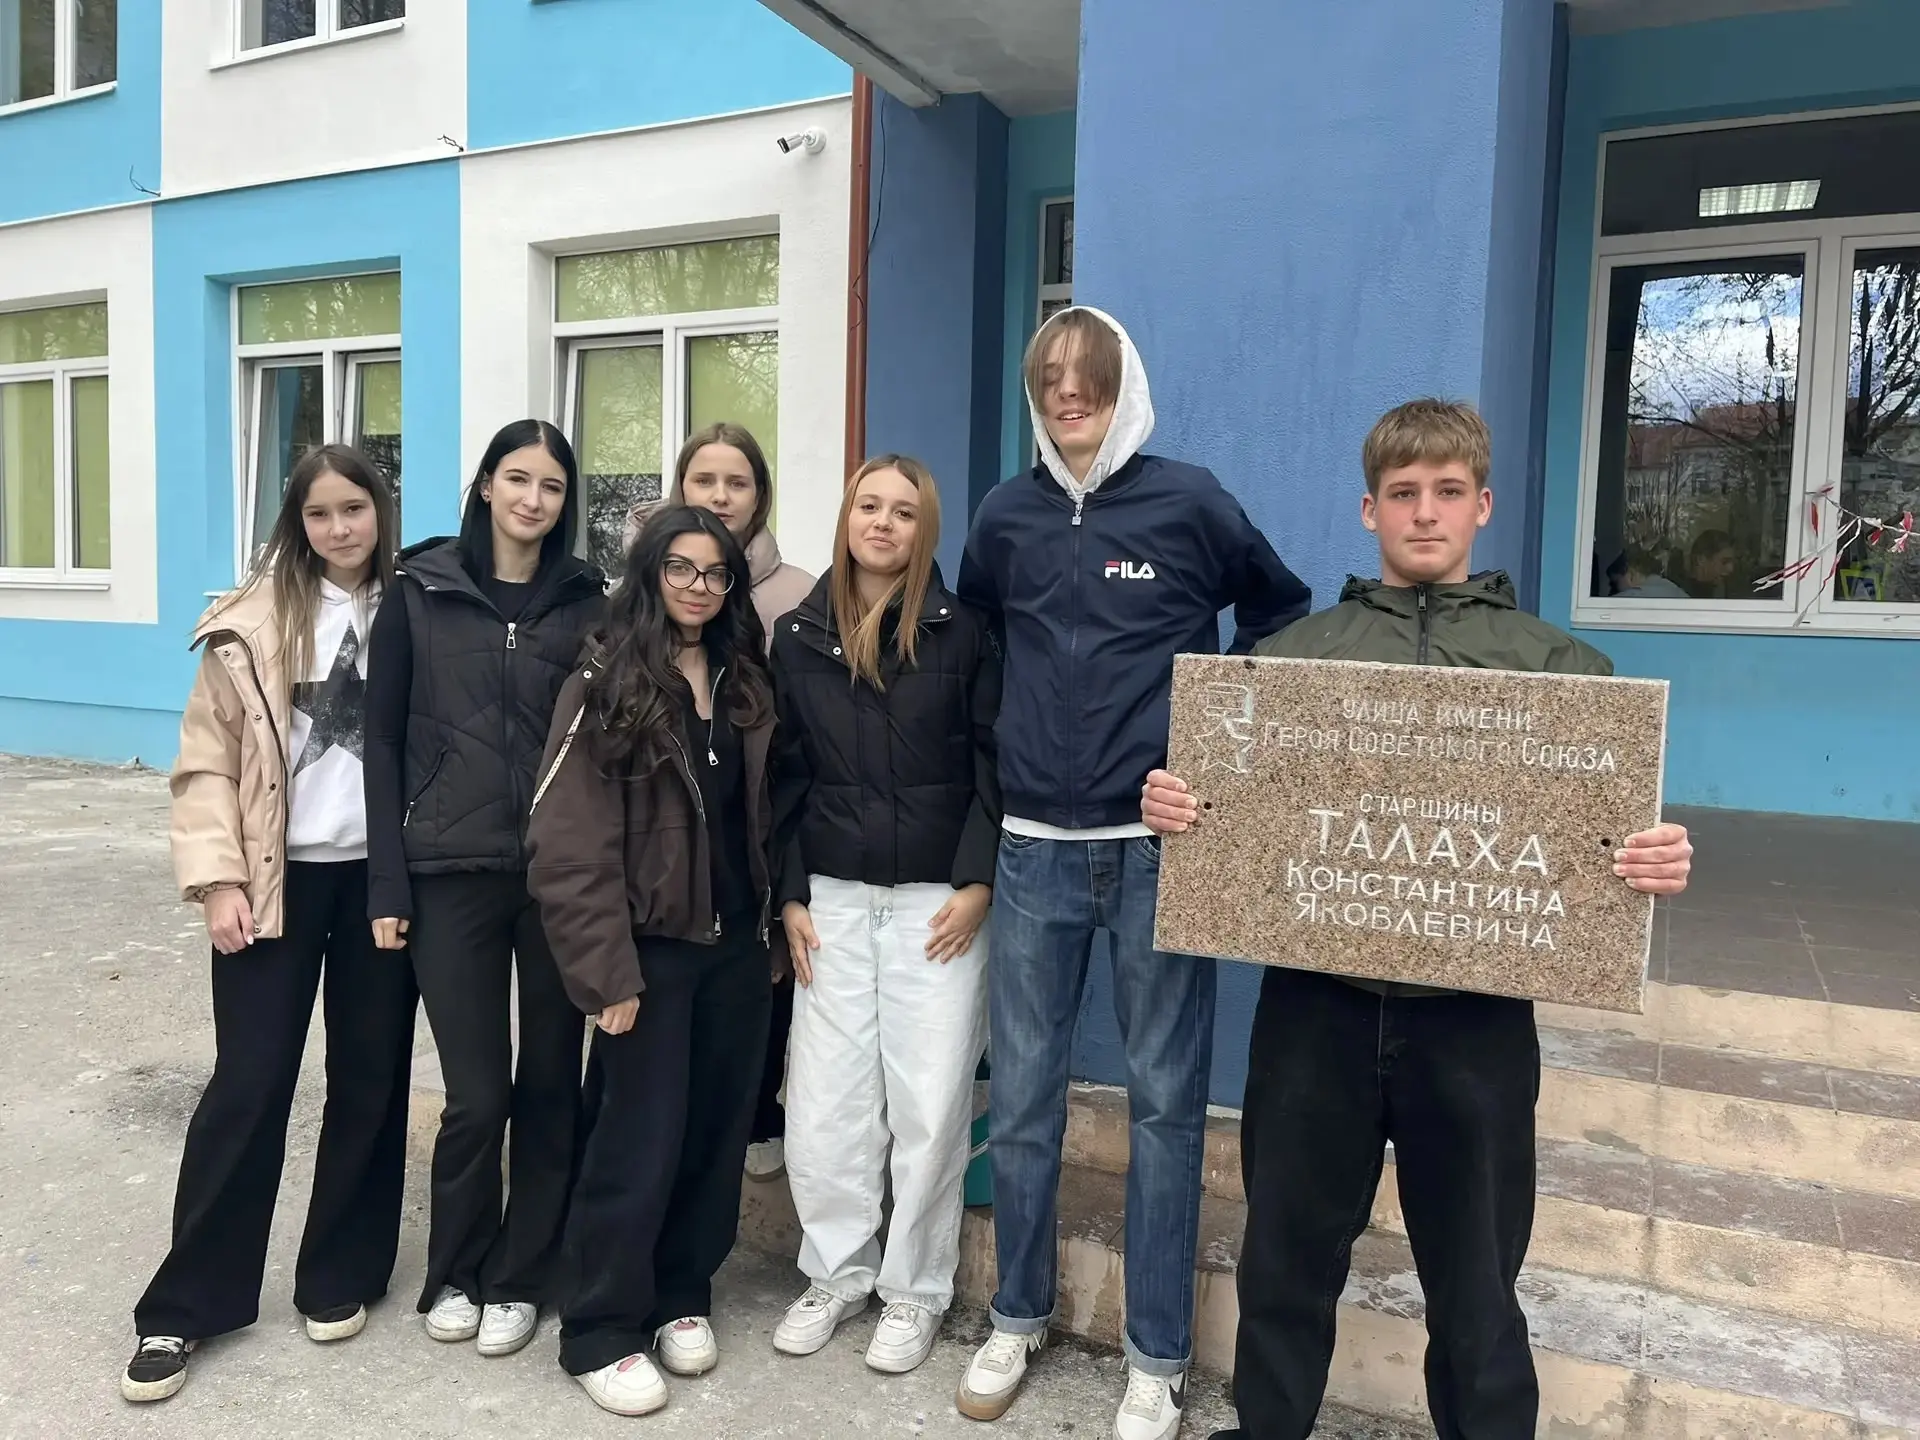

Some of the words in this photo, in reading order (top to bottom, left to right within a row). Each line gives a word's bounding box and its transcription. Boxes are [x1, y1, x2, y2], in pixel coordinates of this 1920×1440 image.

[1104, 561, 1156, 579] FILA
[1342, 699, 1421, 725] УЛИЦА
[1436, 706, 1533, 731] ИМЕНИ
[1263, 721, 1340, 751] ГЕРОЯ
[1521, 737, 1617, 773] СОЮЗА
[1359, 793, 1502, 825] СТАРШИНЫ
[1308, 808, 1549, 876] ТАЛАХА
[1286, 858, 1566, 918] КОНСТАНТИНА
[1295, 893, 1558, 951] ЯКОВЛЕВИЧА
